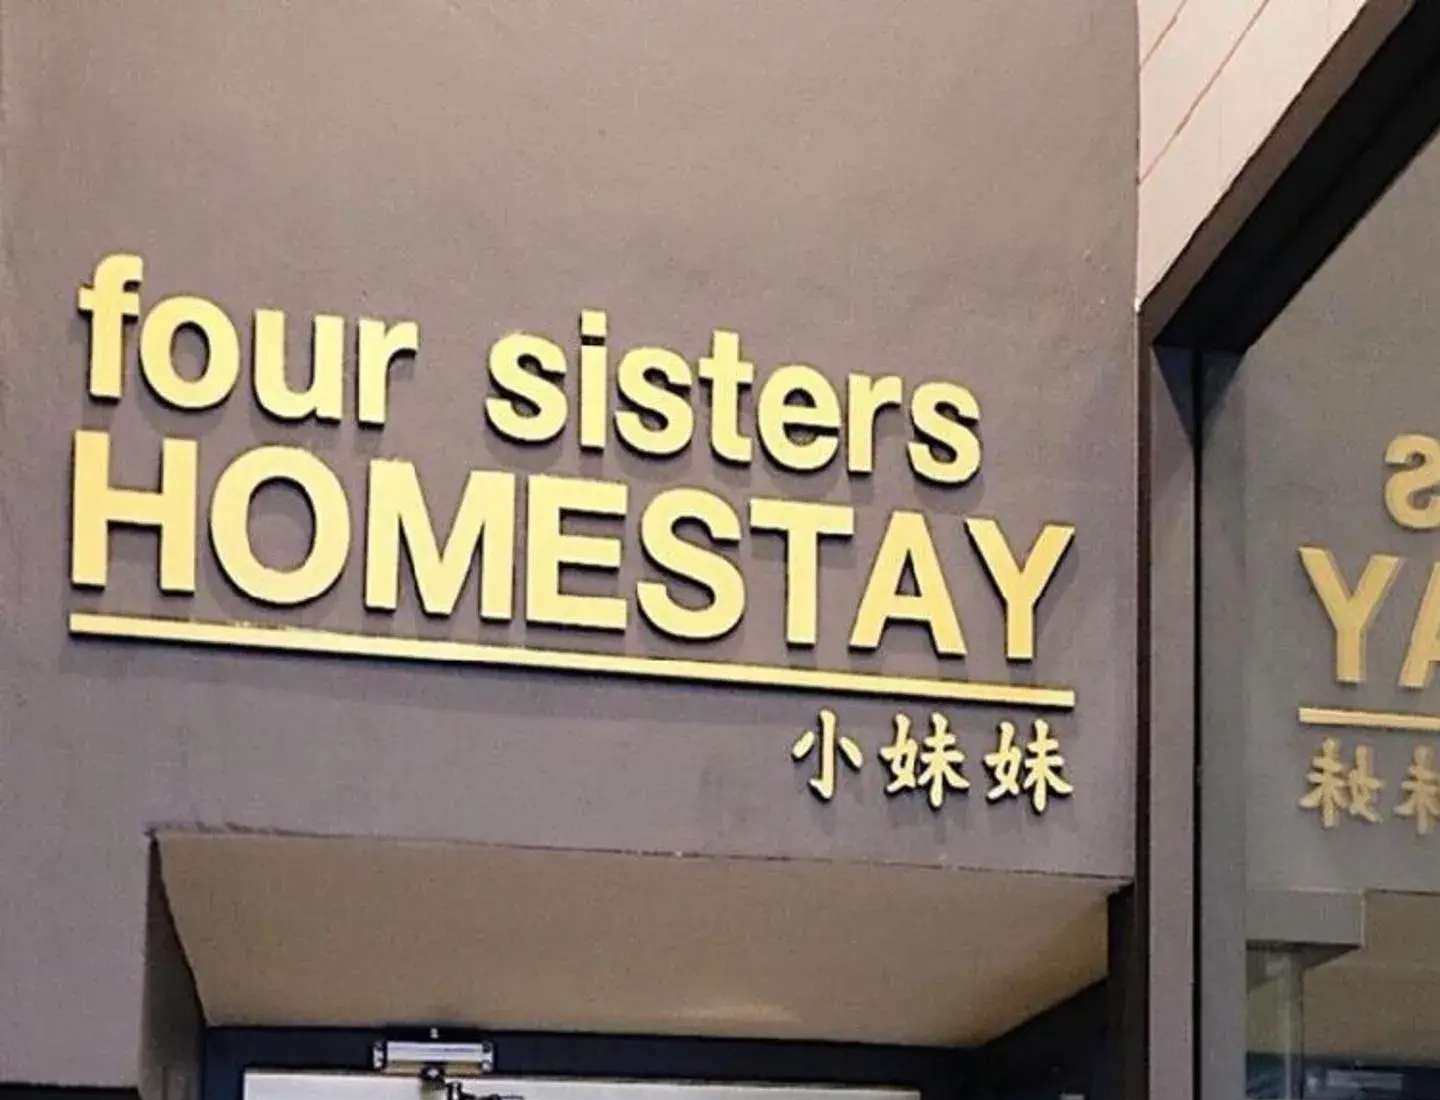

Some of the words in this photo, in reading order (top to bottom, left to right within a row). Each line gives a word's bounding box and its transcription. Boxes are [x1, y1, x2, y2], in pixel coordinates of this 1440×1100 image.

[78, 253, 419, 425] four
[486, 309, 983, 484] sisters
[70, 428, 1076, 660] HOMESTAY
[791, 709, 1075, 812] 小妹妹
